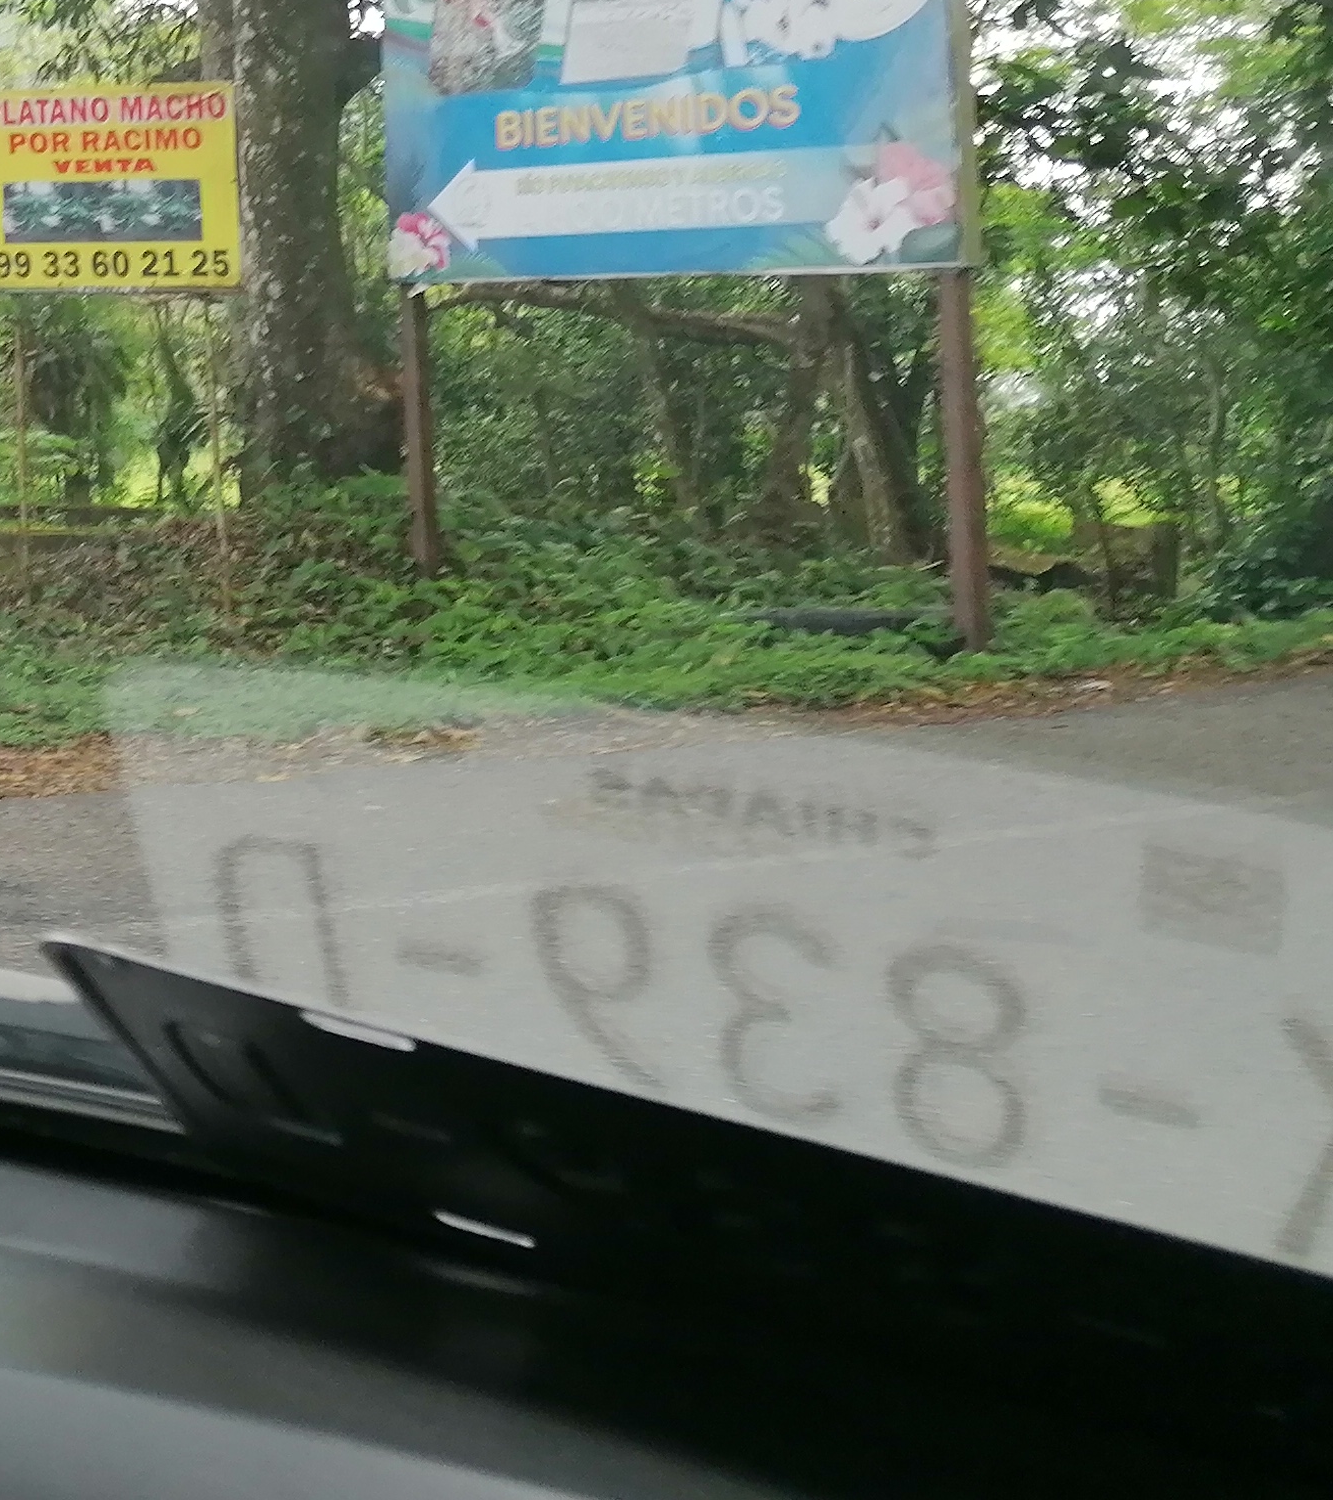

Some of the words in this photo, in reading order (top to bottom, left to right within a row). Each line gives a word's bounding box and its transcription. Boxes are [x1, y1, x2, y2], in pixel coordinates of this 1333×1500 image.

[120, 91, 226, 122] MACHO
[494, 84, 802, 151] BIENVENIDOS
[9, 131, 71, 154] POR
[82, 126, 203, 152] RACIMO
[53, 157, 157, 175] VENTA
[43, 250, 80, 278] 33
[92, 250, 130, 277] 60
[140, 249, 180, 277] 21
[191, 249, 231, 277] 25
